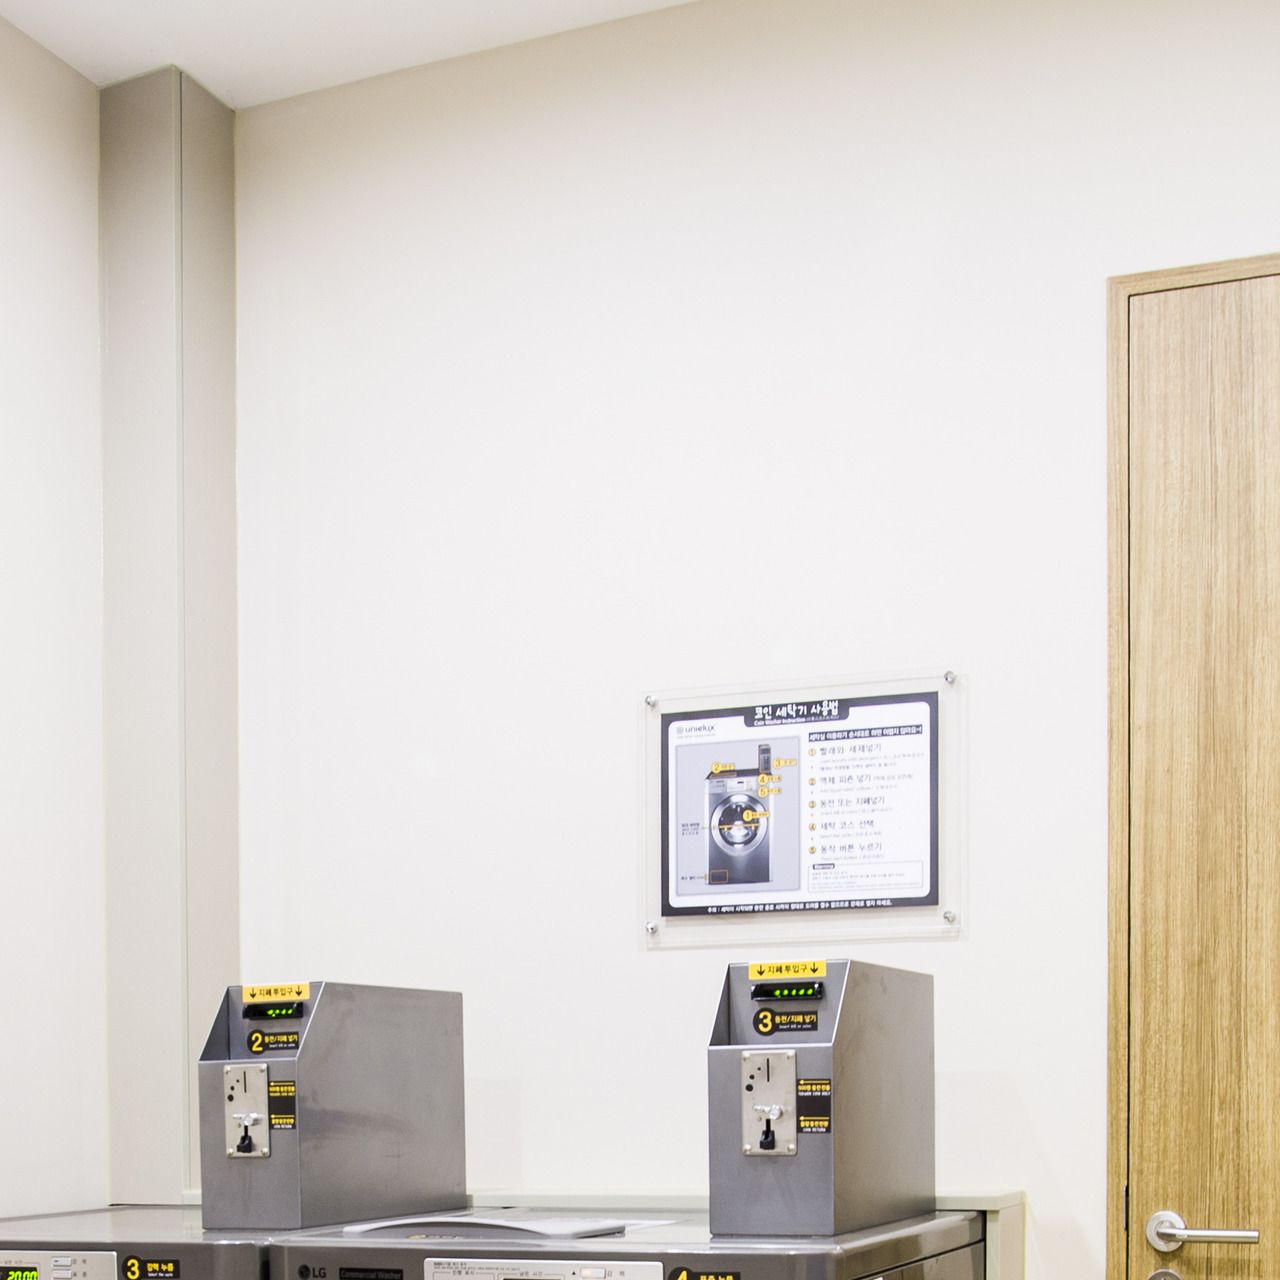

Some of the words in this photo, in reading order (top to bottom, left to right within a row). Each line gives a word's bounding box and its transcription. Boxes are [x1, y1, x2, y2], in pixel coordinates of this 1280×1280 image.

[754, 706, 772, 720] 코인
[776, 704, 807, 718] 세탁기
[810, 699, 839, 716] 사용법
[758, 1011, 773, 1033] 3
[251, 1033, 263, 1052] 2
[127, 1259, 139, 1280] 3
[312, 1267, 326, 1278] LG
